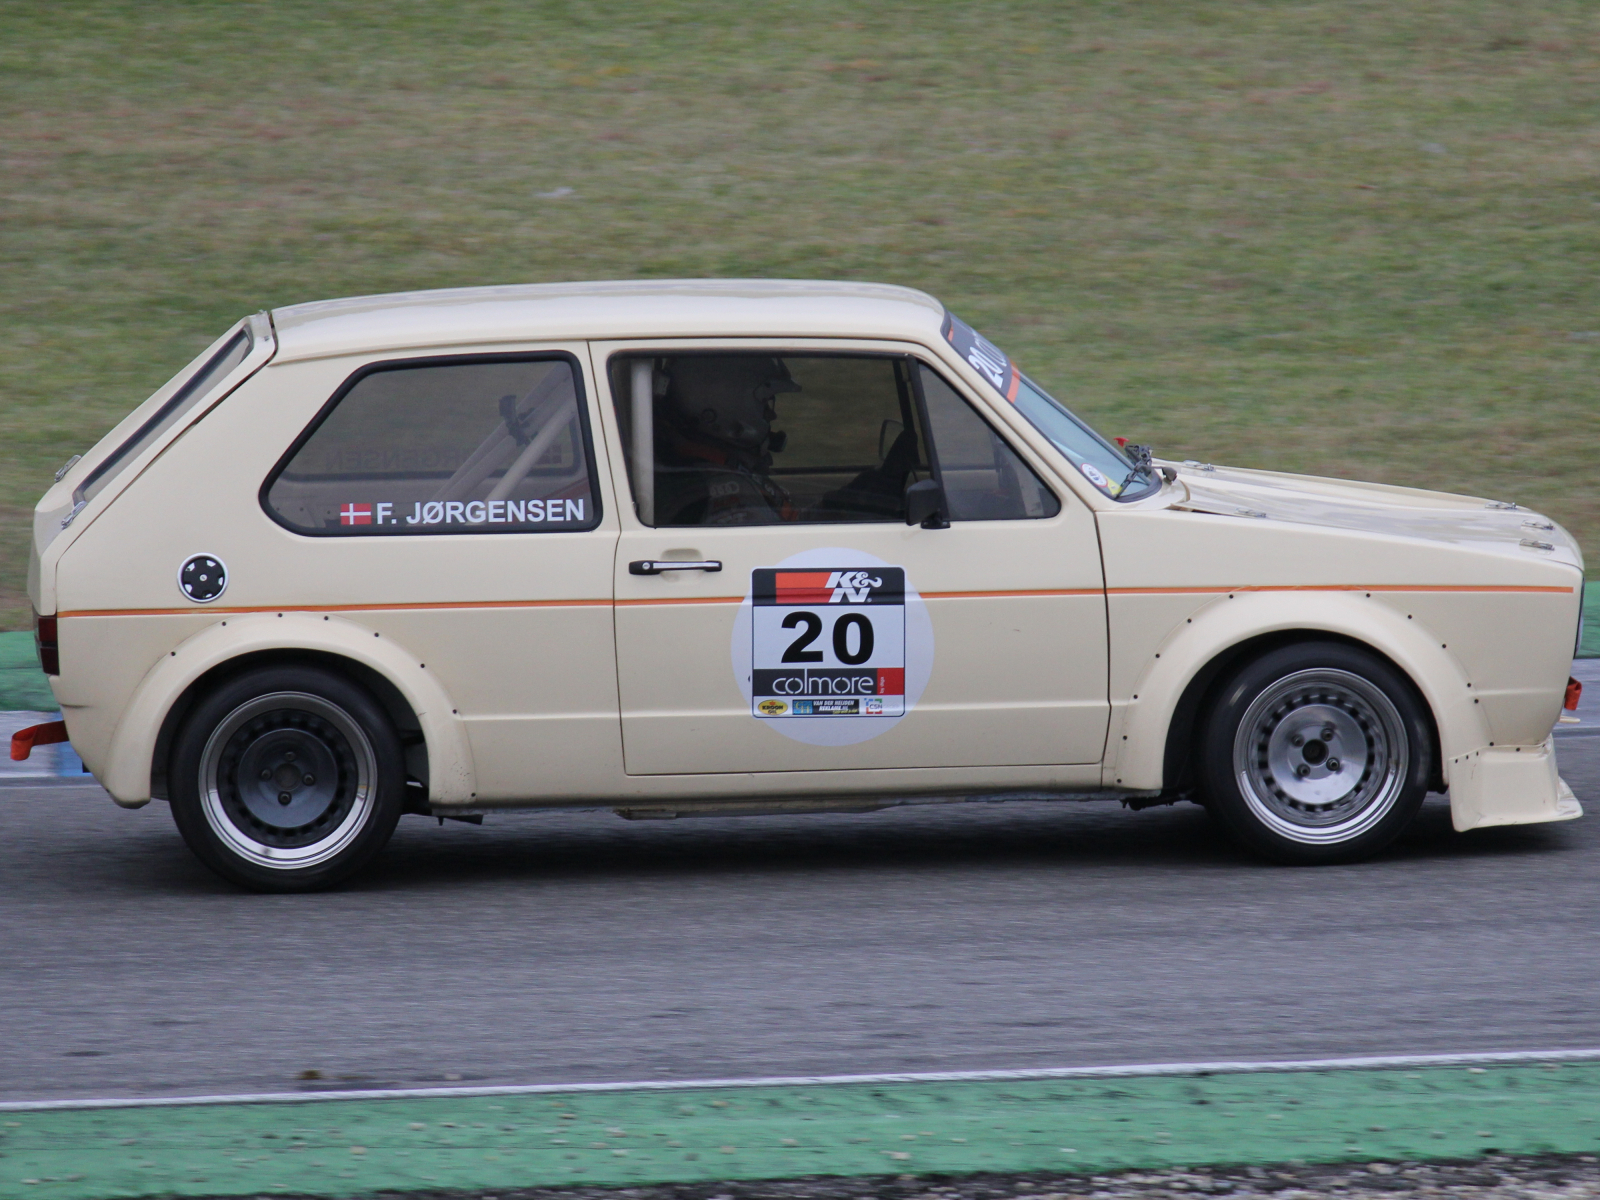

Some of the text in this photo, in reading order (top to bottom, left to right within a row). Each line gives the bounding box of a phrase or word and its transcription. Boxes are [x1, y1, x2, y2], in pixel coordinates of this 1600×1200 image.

[377, 498, 585, 524] F. JØRGENSEN
[781, 611, 875, 666] 20
[772, 669, 874, 695] colmore
